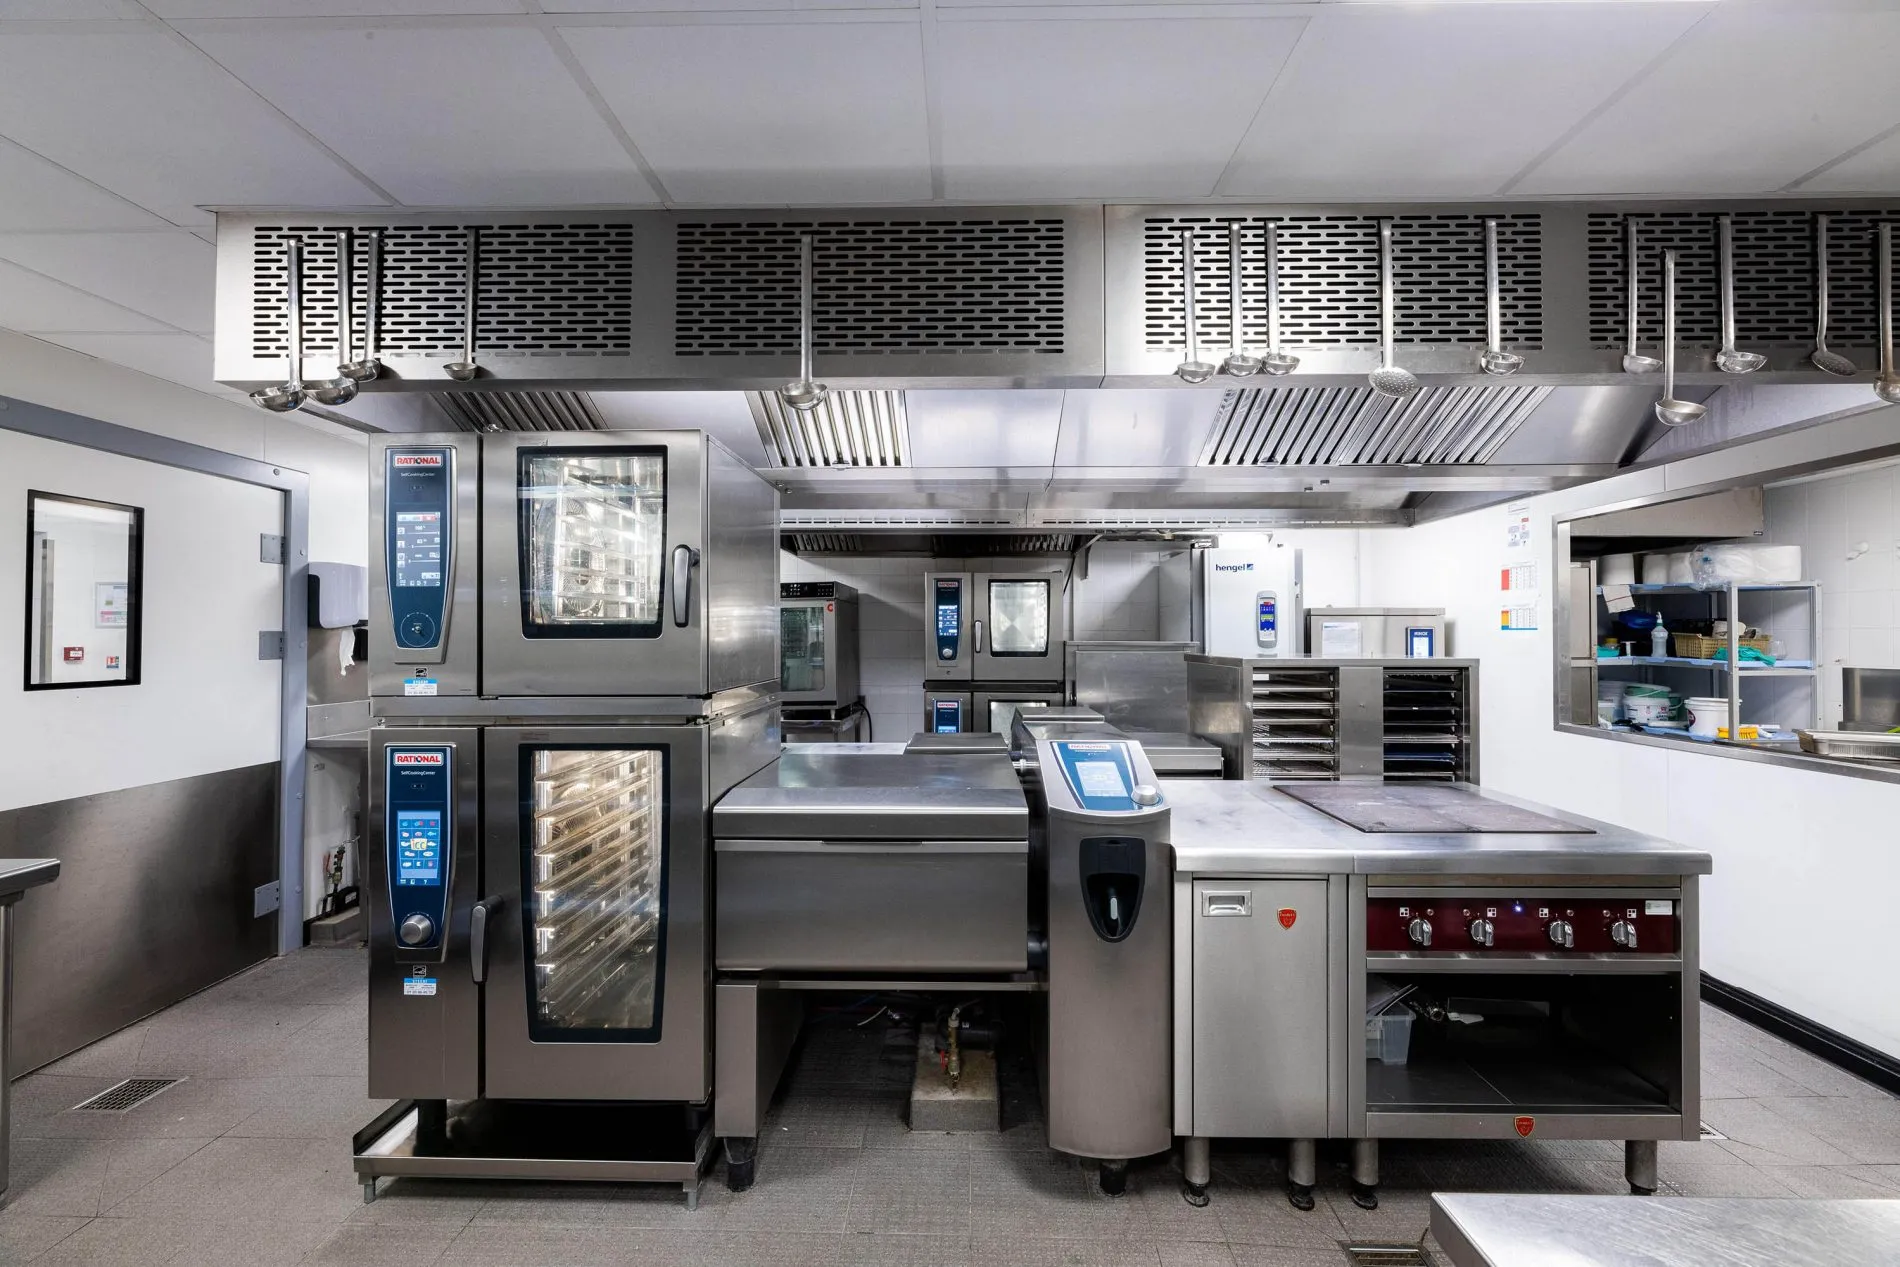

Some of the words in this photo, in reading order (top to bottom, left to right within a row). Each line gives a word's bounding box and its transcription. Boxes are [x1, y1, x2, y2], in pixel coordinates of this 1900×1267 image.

[396, 457, 440, 465] RATIONAL
[1215, 563, 1246, 573] hengel
[396, 755, 440, 763] RATIONAL
[412, 838, 425, 849] icc
